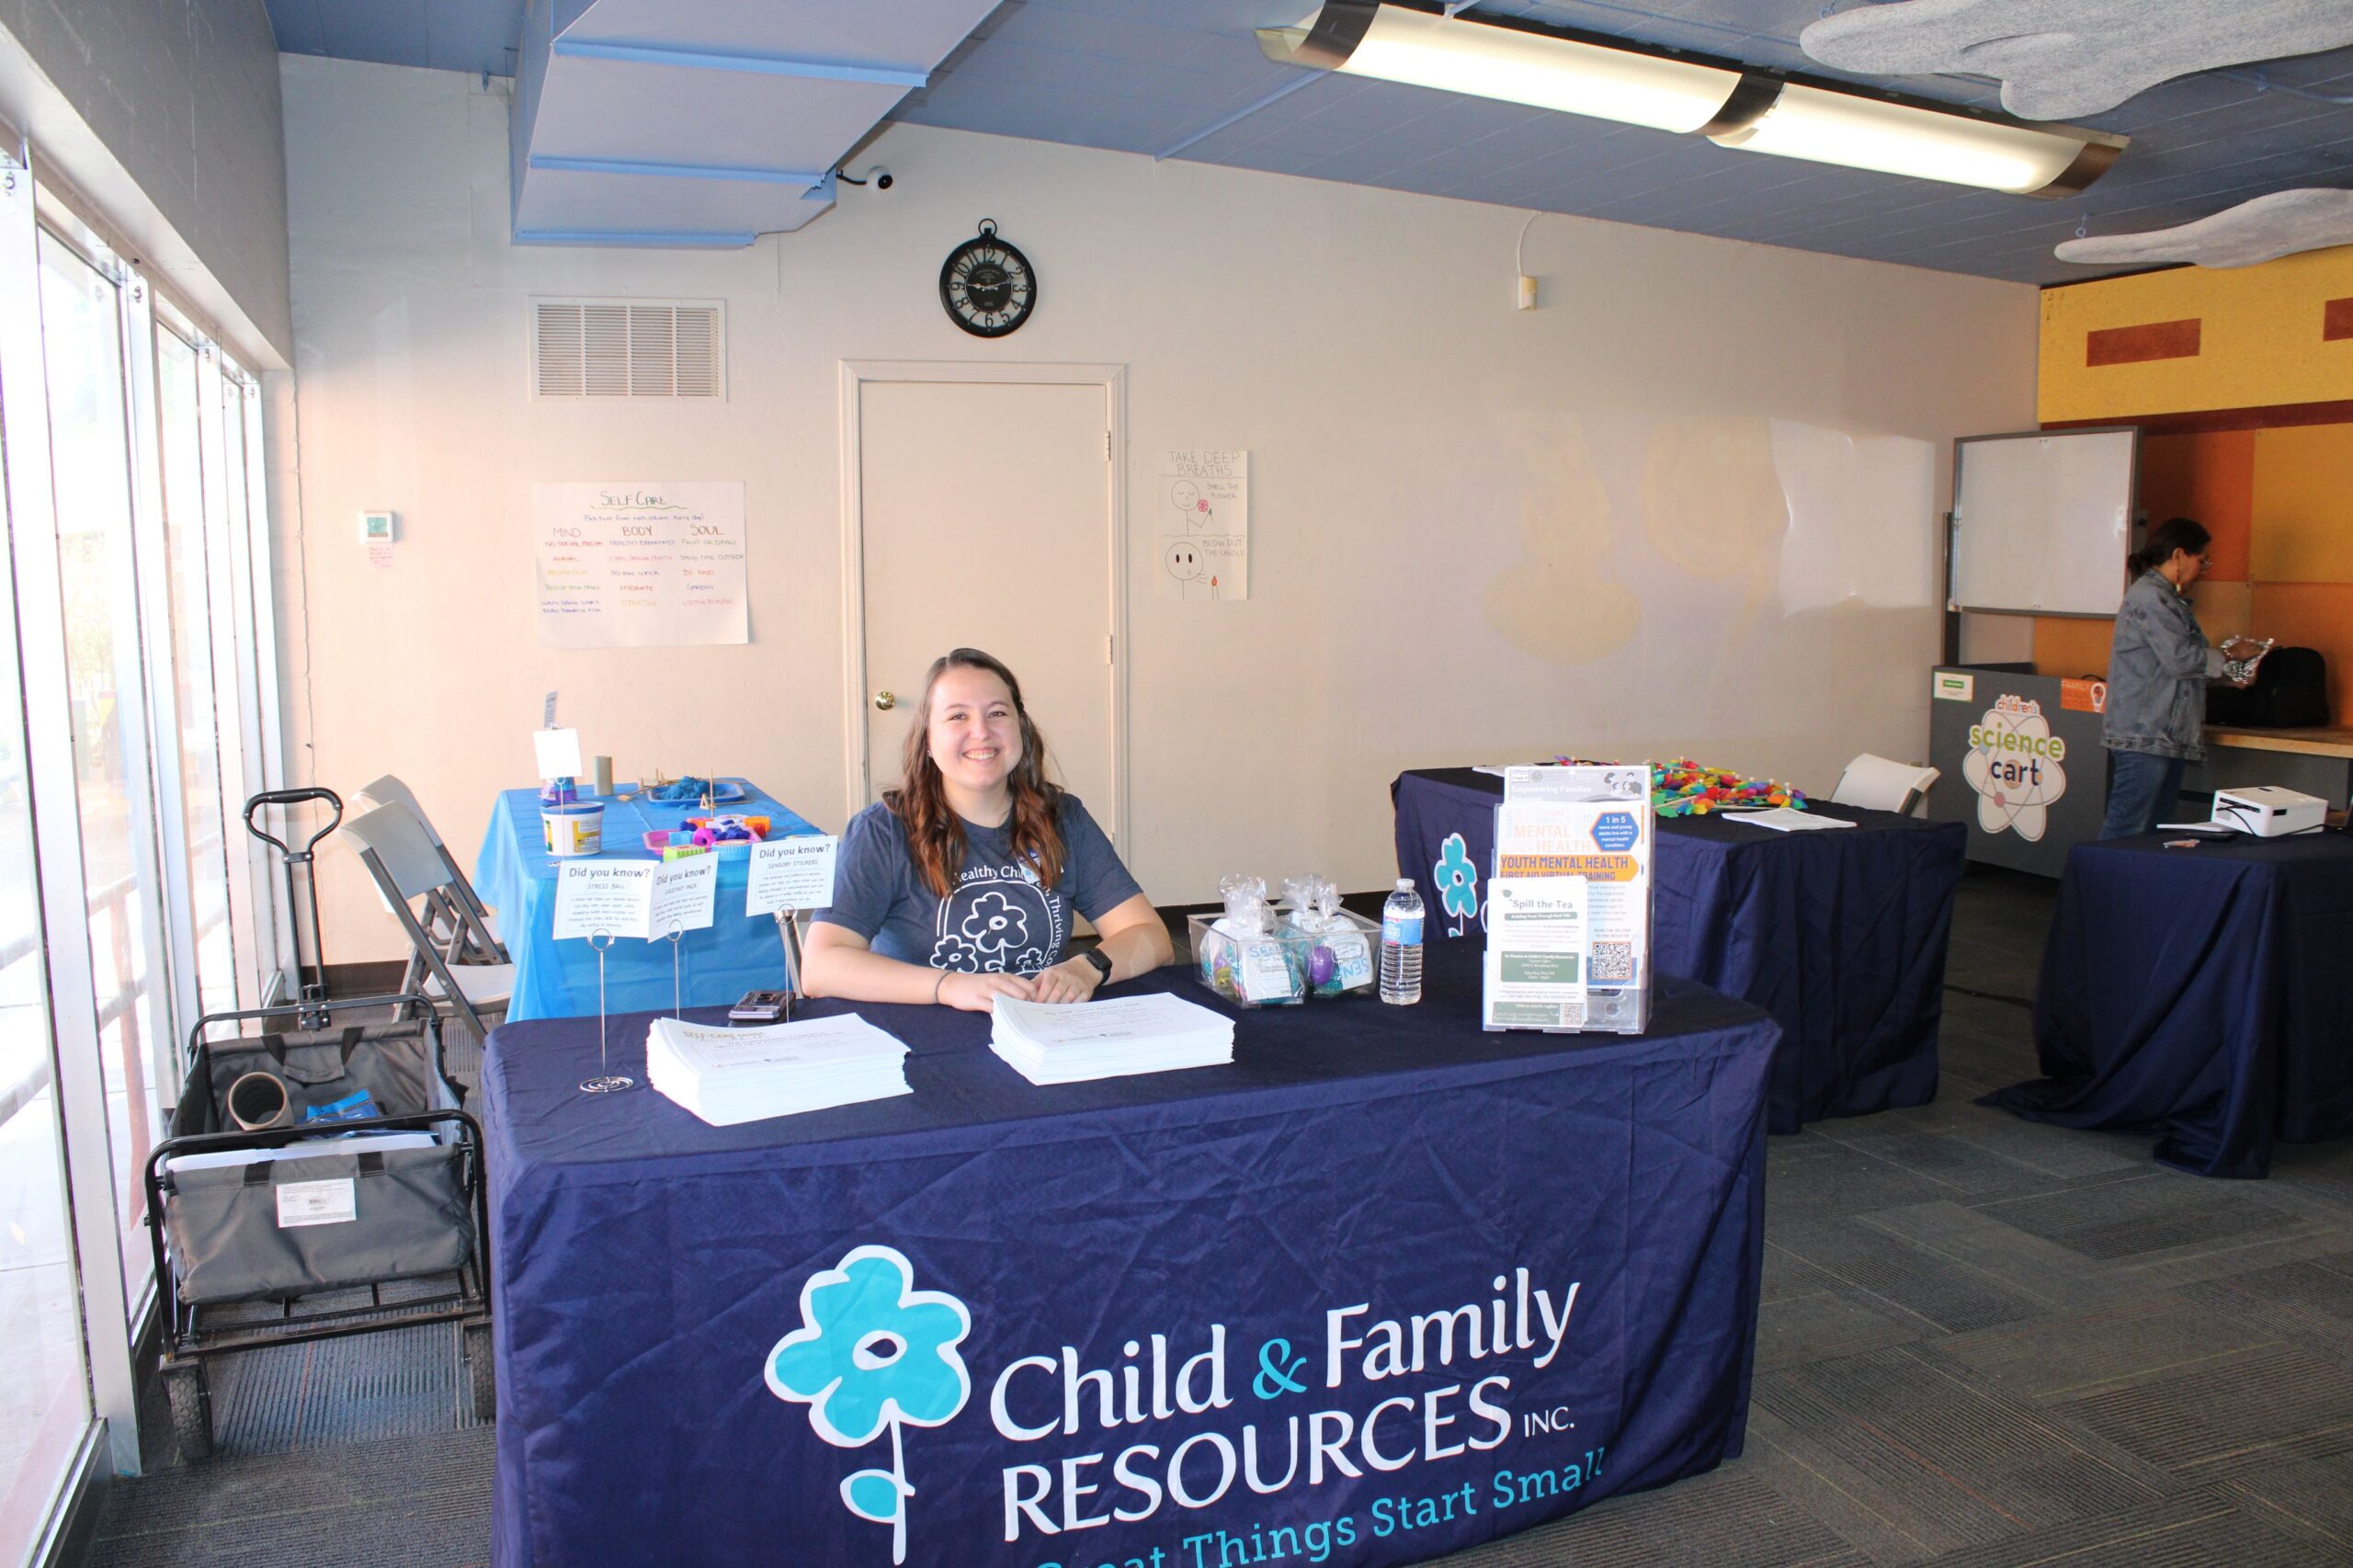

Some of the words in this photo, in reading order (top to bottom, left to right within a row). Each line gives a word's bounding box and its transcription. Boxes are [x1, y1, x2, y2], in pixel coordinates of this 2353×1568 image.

[1167, 450, 1199, 463] TAKE
[1203, 449, 1241, 464] DEEP
[1176, 463, 1233, 477] BREATHS
[599, 491, 634, 506] SELF
[635, 490, 666, 506] CARE
[551, 527, 582, 538] MIND
[621, 525, 653, 537] BODY
[689, 524, 726, 537] SOUL
[1970, 722, 2063, 759] science
[1991, 758, 2040, 787] cart
[1515, 825, 1572, 839] MENTAL
[759, 848, 776, 859] Did
[778, 847, 795, 859] you
[798, 843, 831, 854] know?
[1537, 839, 1591, 853] HEALTH
[1501, 857, 1536, 869] YOUTH
[1539, 857, 1582, 869] MENTAL
[1585, 857, 1629, 869] HEALTH
[569, 867, 587, 878] Did
[589, 869, 610, 880] you
[612, 867, 651, 878] know?
[656, 874, 668, 886] Did
[669, 872, 683, 884] you
[684, 865, 711, 879] know?
[1537, 898, 1553, 909] the
[1555, 900, 1574, 909] Tea
[1048, 895, 1064, 949] Thriving
[990, 1323, 1234, 1442] Child
[1252, 1337, 1308, 1401] &
[1325, 1267, 1581, 1389] Family
[1002, 1375, 1512, 1543] RESOURCES
[1523, 1405, 1575, 1438] INC.
[1183, 1514, 1357, 1568] Things
[1371, 1482, 1477, 1538] Start
[1492, 1447, 1607, 1510] Small
